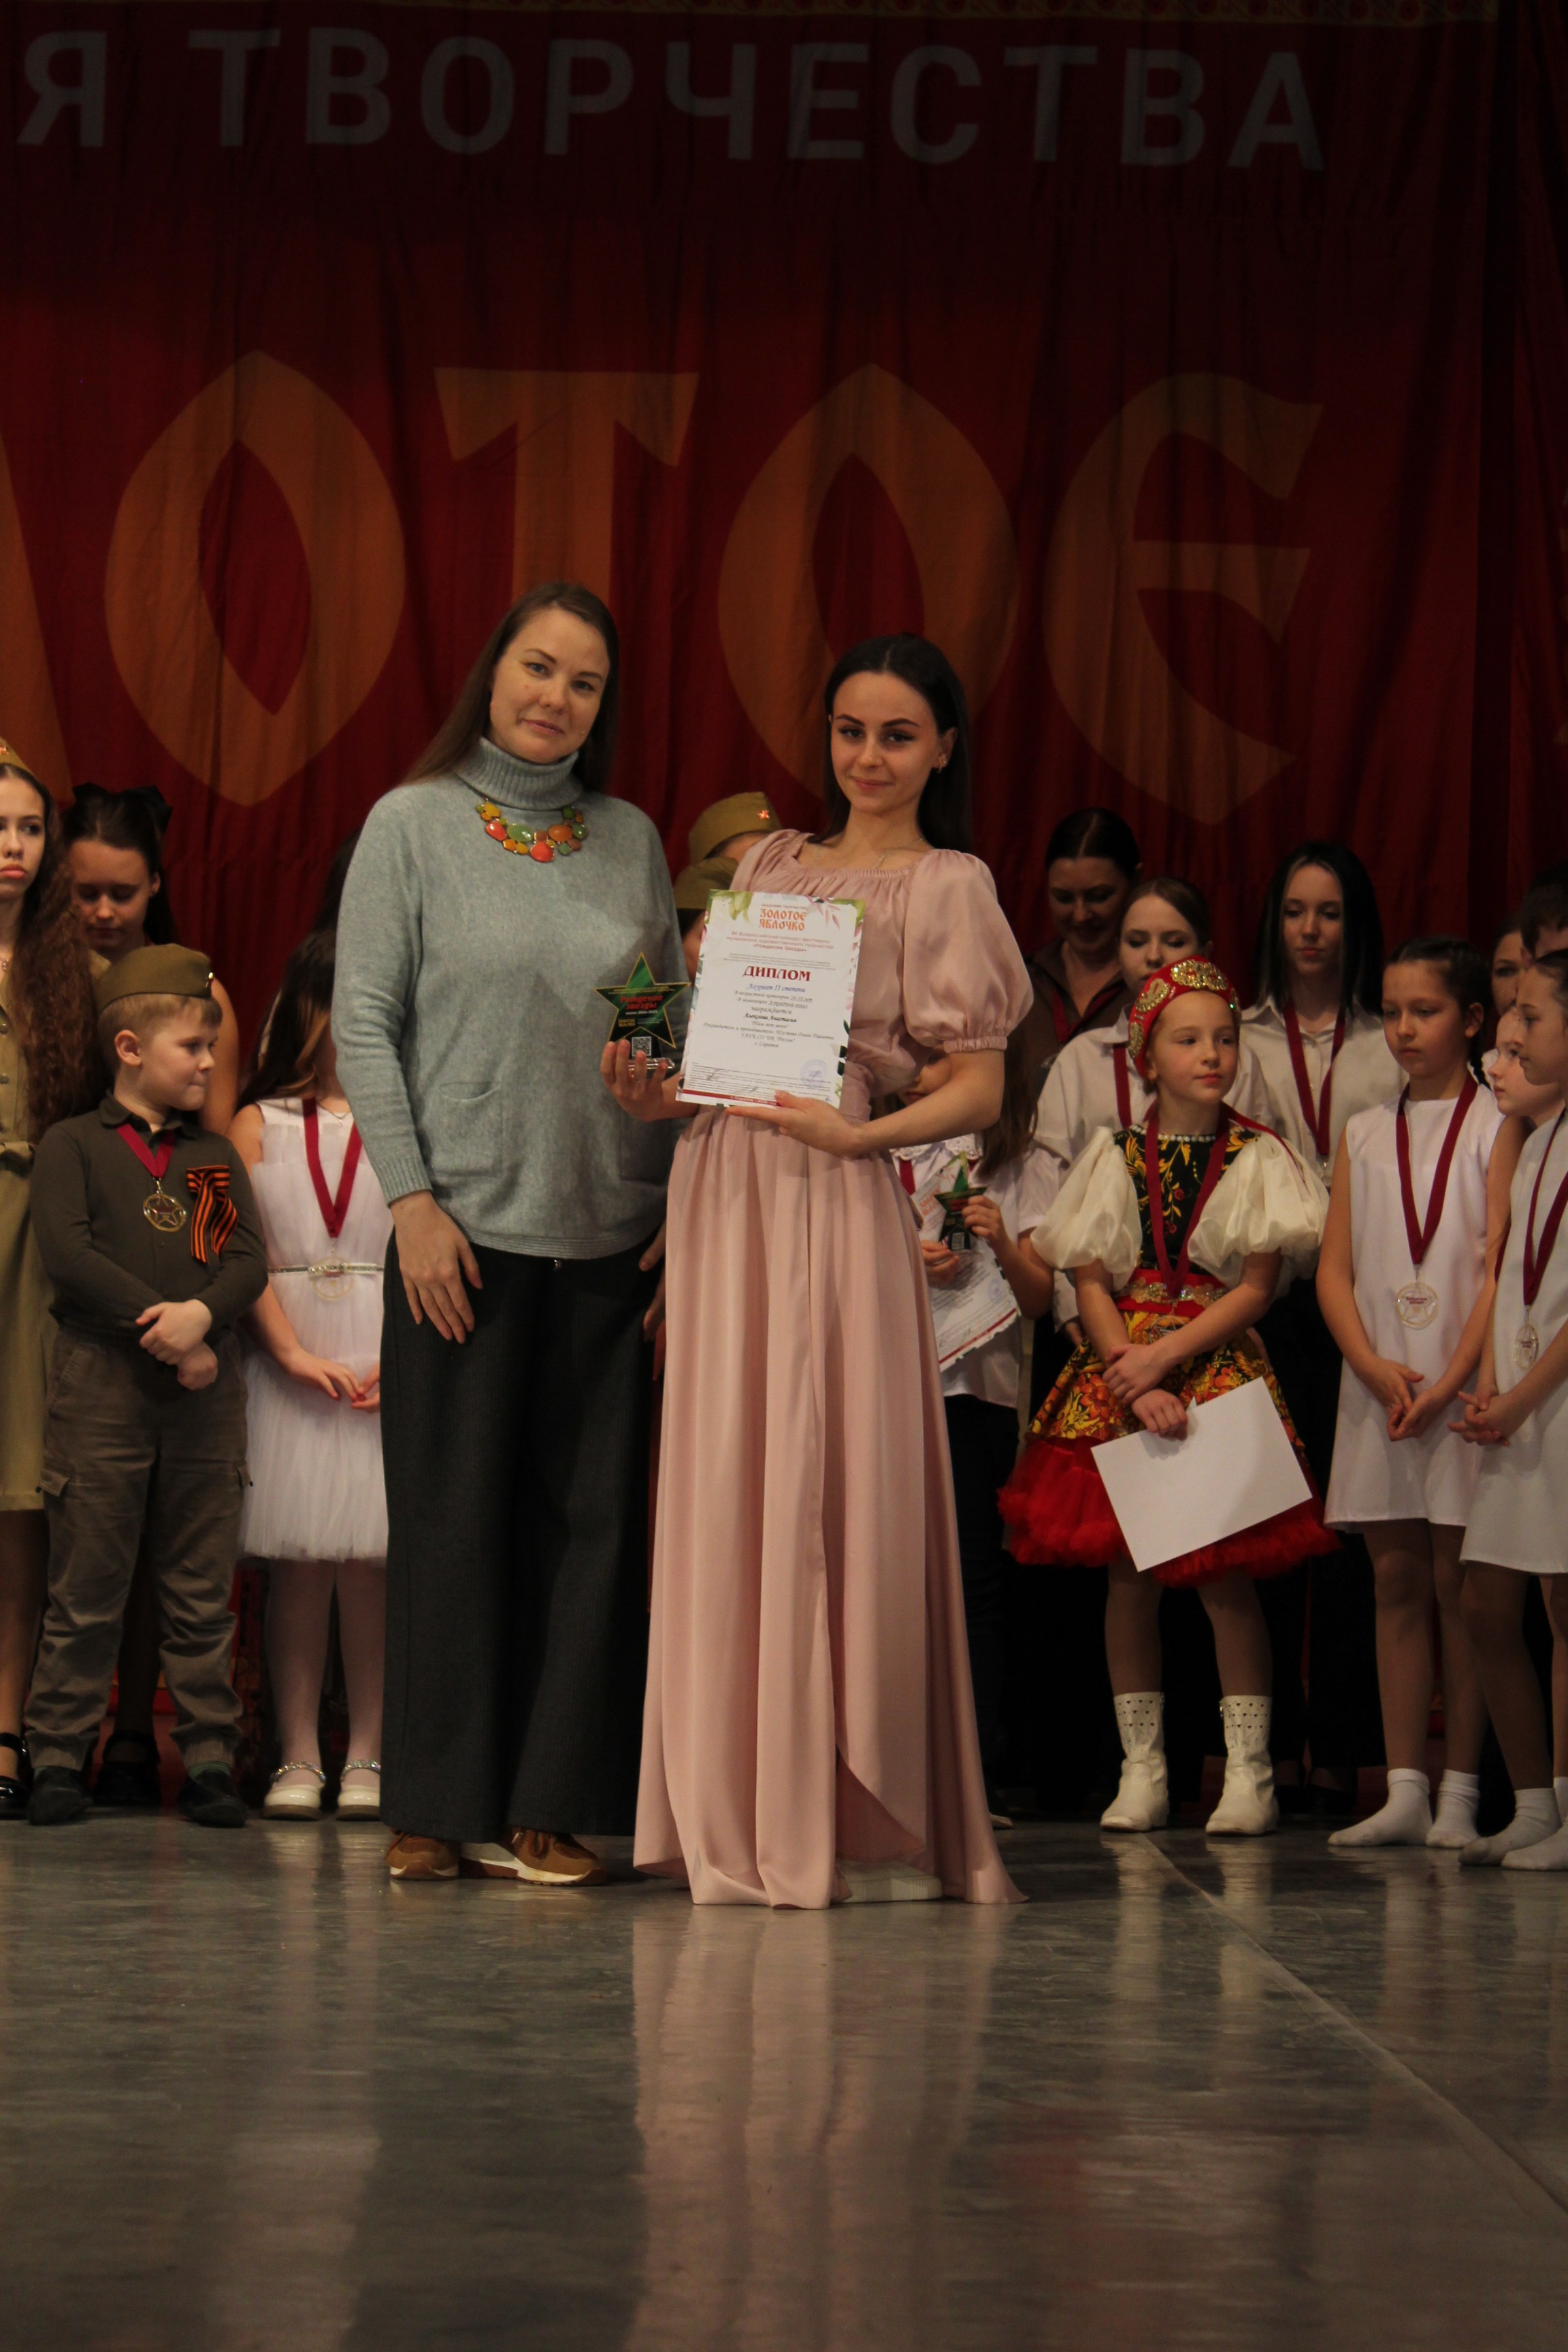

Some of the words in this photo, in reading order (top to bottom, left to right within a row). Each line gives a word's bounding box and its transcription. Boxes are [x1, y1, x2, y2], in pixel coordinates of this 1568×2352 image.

[18, 32, 108, 148] Я
[189, 27, 1326, 172] ТВОРЧЕСТВА
[0, 350, 1324, 824] ОТОЕ
[760, 909, 806, 921] ЗОЛОТОЕ
[759, 919, 805, 931] ЯБЛОЧКО
[742, 966, 811, 982] ДИПЛОМ
